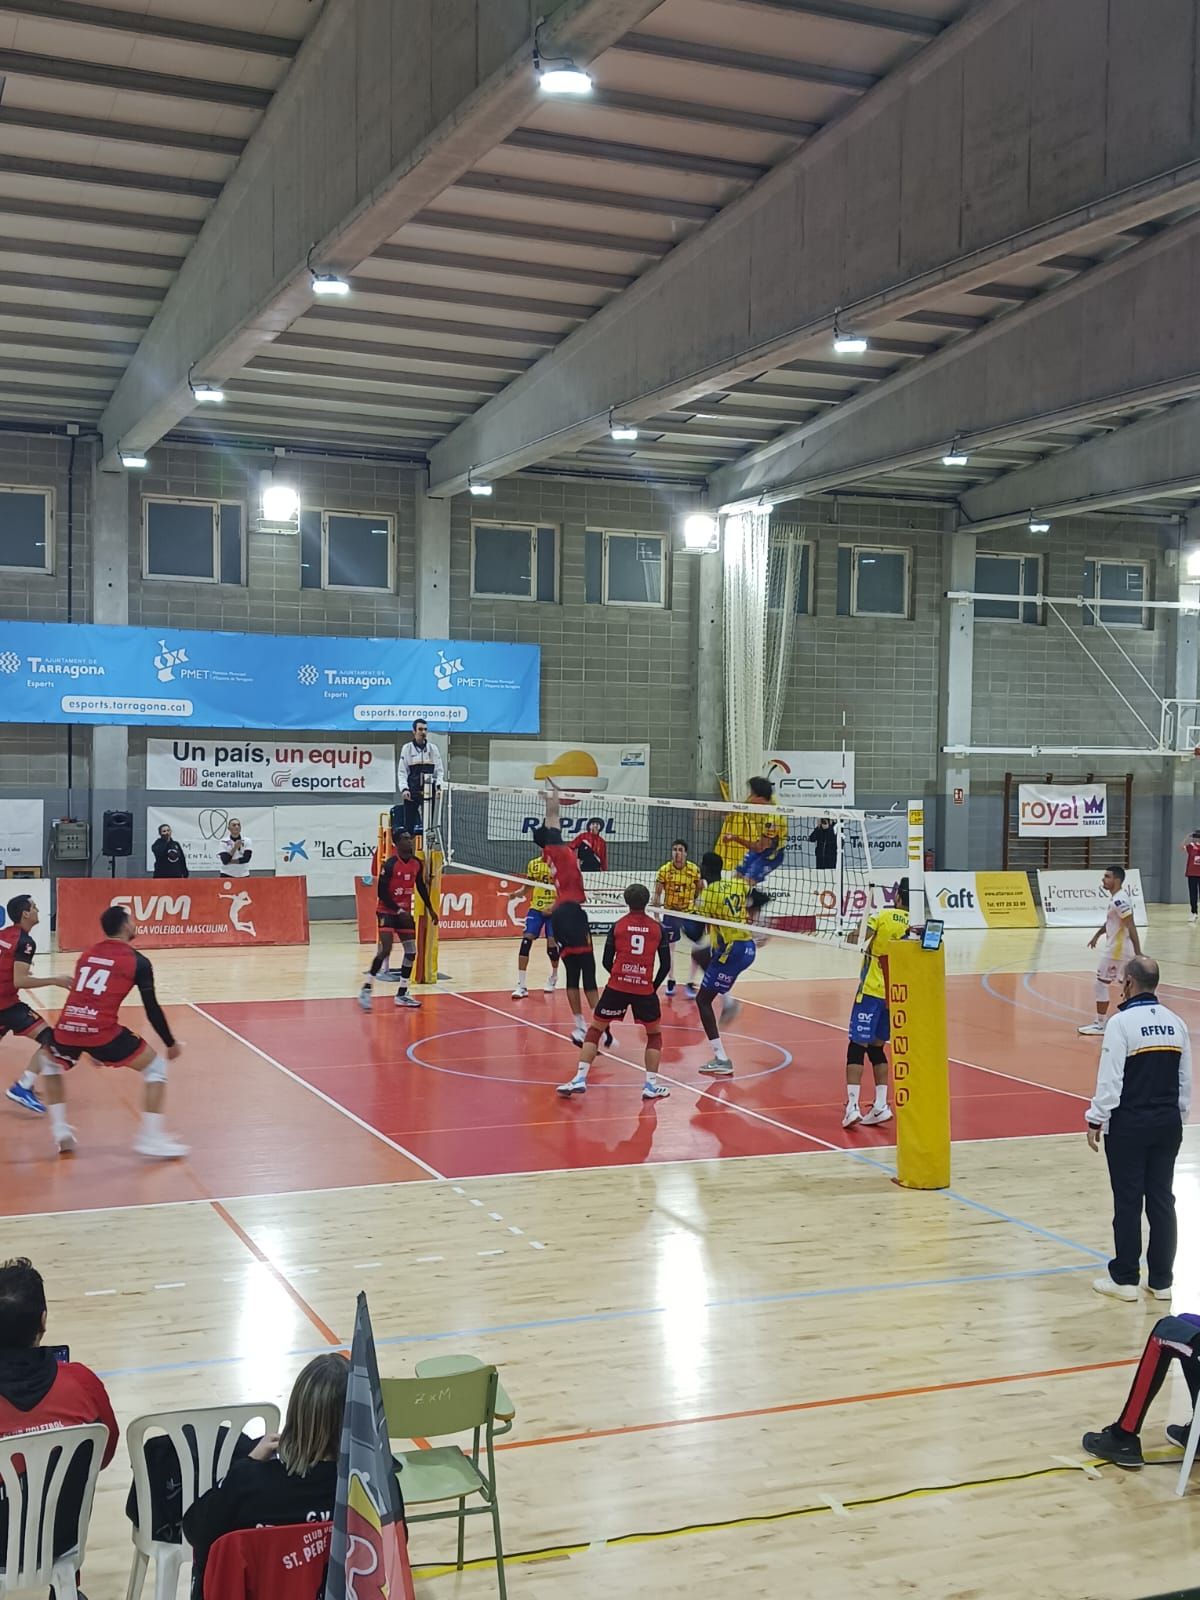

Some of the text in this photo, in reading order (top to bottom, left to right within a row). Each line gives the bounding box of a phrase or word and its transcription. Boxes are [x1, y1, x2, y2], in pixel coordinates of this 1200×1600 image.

[181, 669, 209, 680] PMET
[27, 680, 54, 688] Esports
[457, 677, 482, 688] PMET
[69, 700, 186, 712] esports.tarragona.cat
[360, 708, 461, 720] esports.tarragona.cat
[173, 742, 373, 769] Un país, un equip
[202, 769, 253, 778] Generalitat
[202, 779, 263, 789] de Catalunya
[292, 775, 365, 790] esportcat
[1022, 795, 1079, 825] royal
[522, 817, 616, 834] RPSOL
[947, 888, 974, 909] aft
[1048, 885, 1097, 899] Ferreres
[1098, 886, 1109, 898] &
[149, 925, 184, 934] VOLEIBOL
[186, 924, 228, 933] MASCULINA
[470, 919, 507, 928] MASCULINA
[631, 934, 645, 955] 9
[75, 966, 111, 995] 14
[1140, 1025, 1176, 1037] RFEVB
[891, 984, 910, 1107] MONDO
[303, 1528, 323, 1544] CLUB
[282, 1551, 303, 1570] ST.
